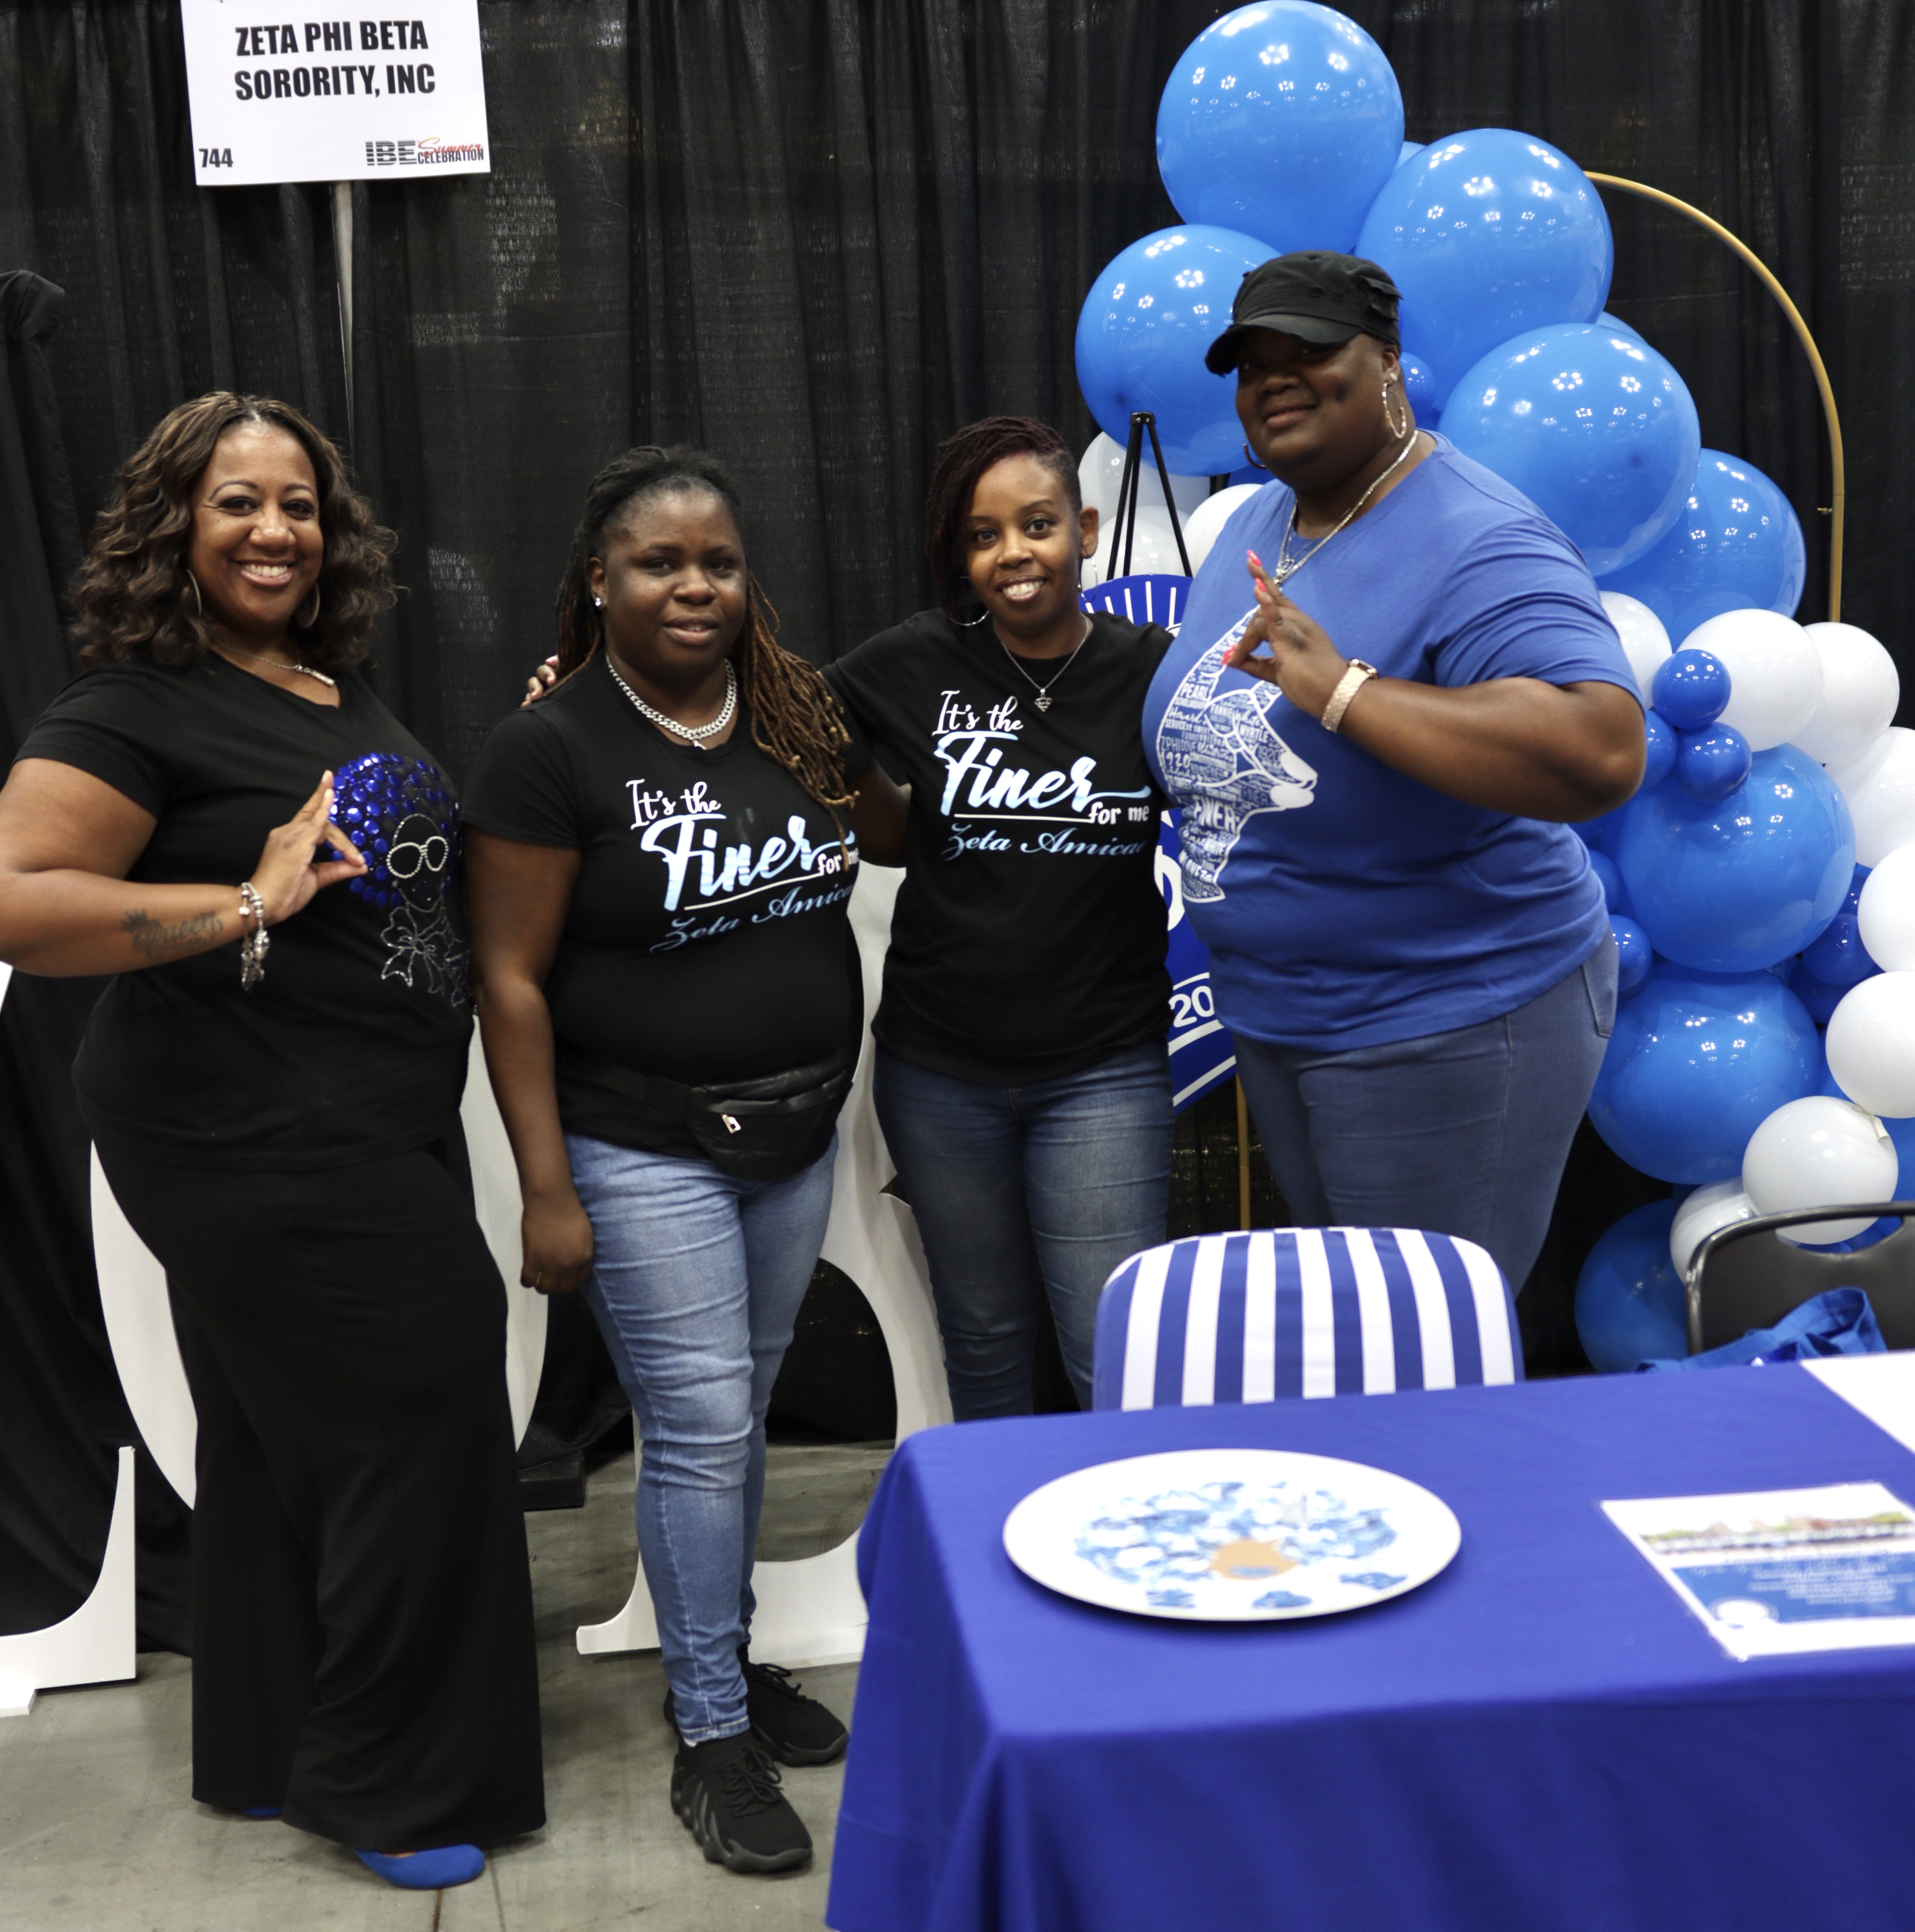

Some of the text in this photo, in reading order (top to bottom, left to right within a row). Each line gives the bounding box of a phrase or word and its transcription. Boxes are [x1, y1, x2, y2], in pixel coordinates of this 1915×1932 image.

[235, 20, 429, 56] ZETA PHI BETA
[234, 64, 436, 100] SORORITY, INC
[199, 148, 234, 168] 744
[365, 140, 417, 166] IBE
[417, 148, 484, 164] CELEBRATION
[418, 137, 483, 156] Summer
[1180, 682, 1210, 701] PEARL
[931, 690, 1024, 736] It's the
[1258, 745, 1280, 762] 1920
[934, 730, 1151, 816] Finer
[625, 778, 721, 830] It's the
[1088, 802, 1150, 825] for me
[942, 823, 1012, 861] Zeta
[641, 813, 856, 911] Finer
[817, 853, 842, 876] for
[650, 916, 741, 952] Zeta
